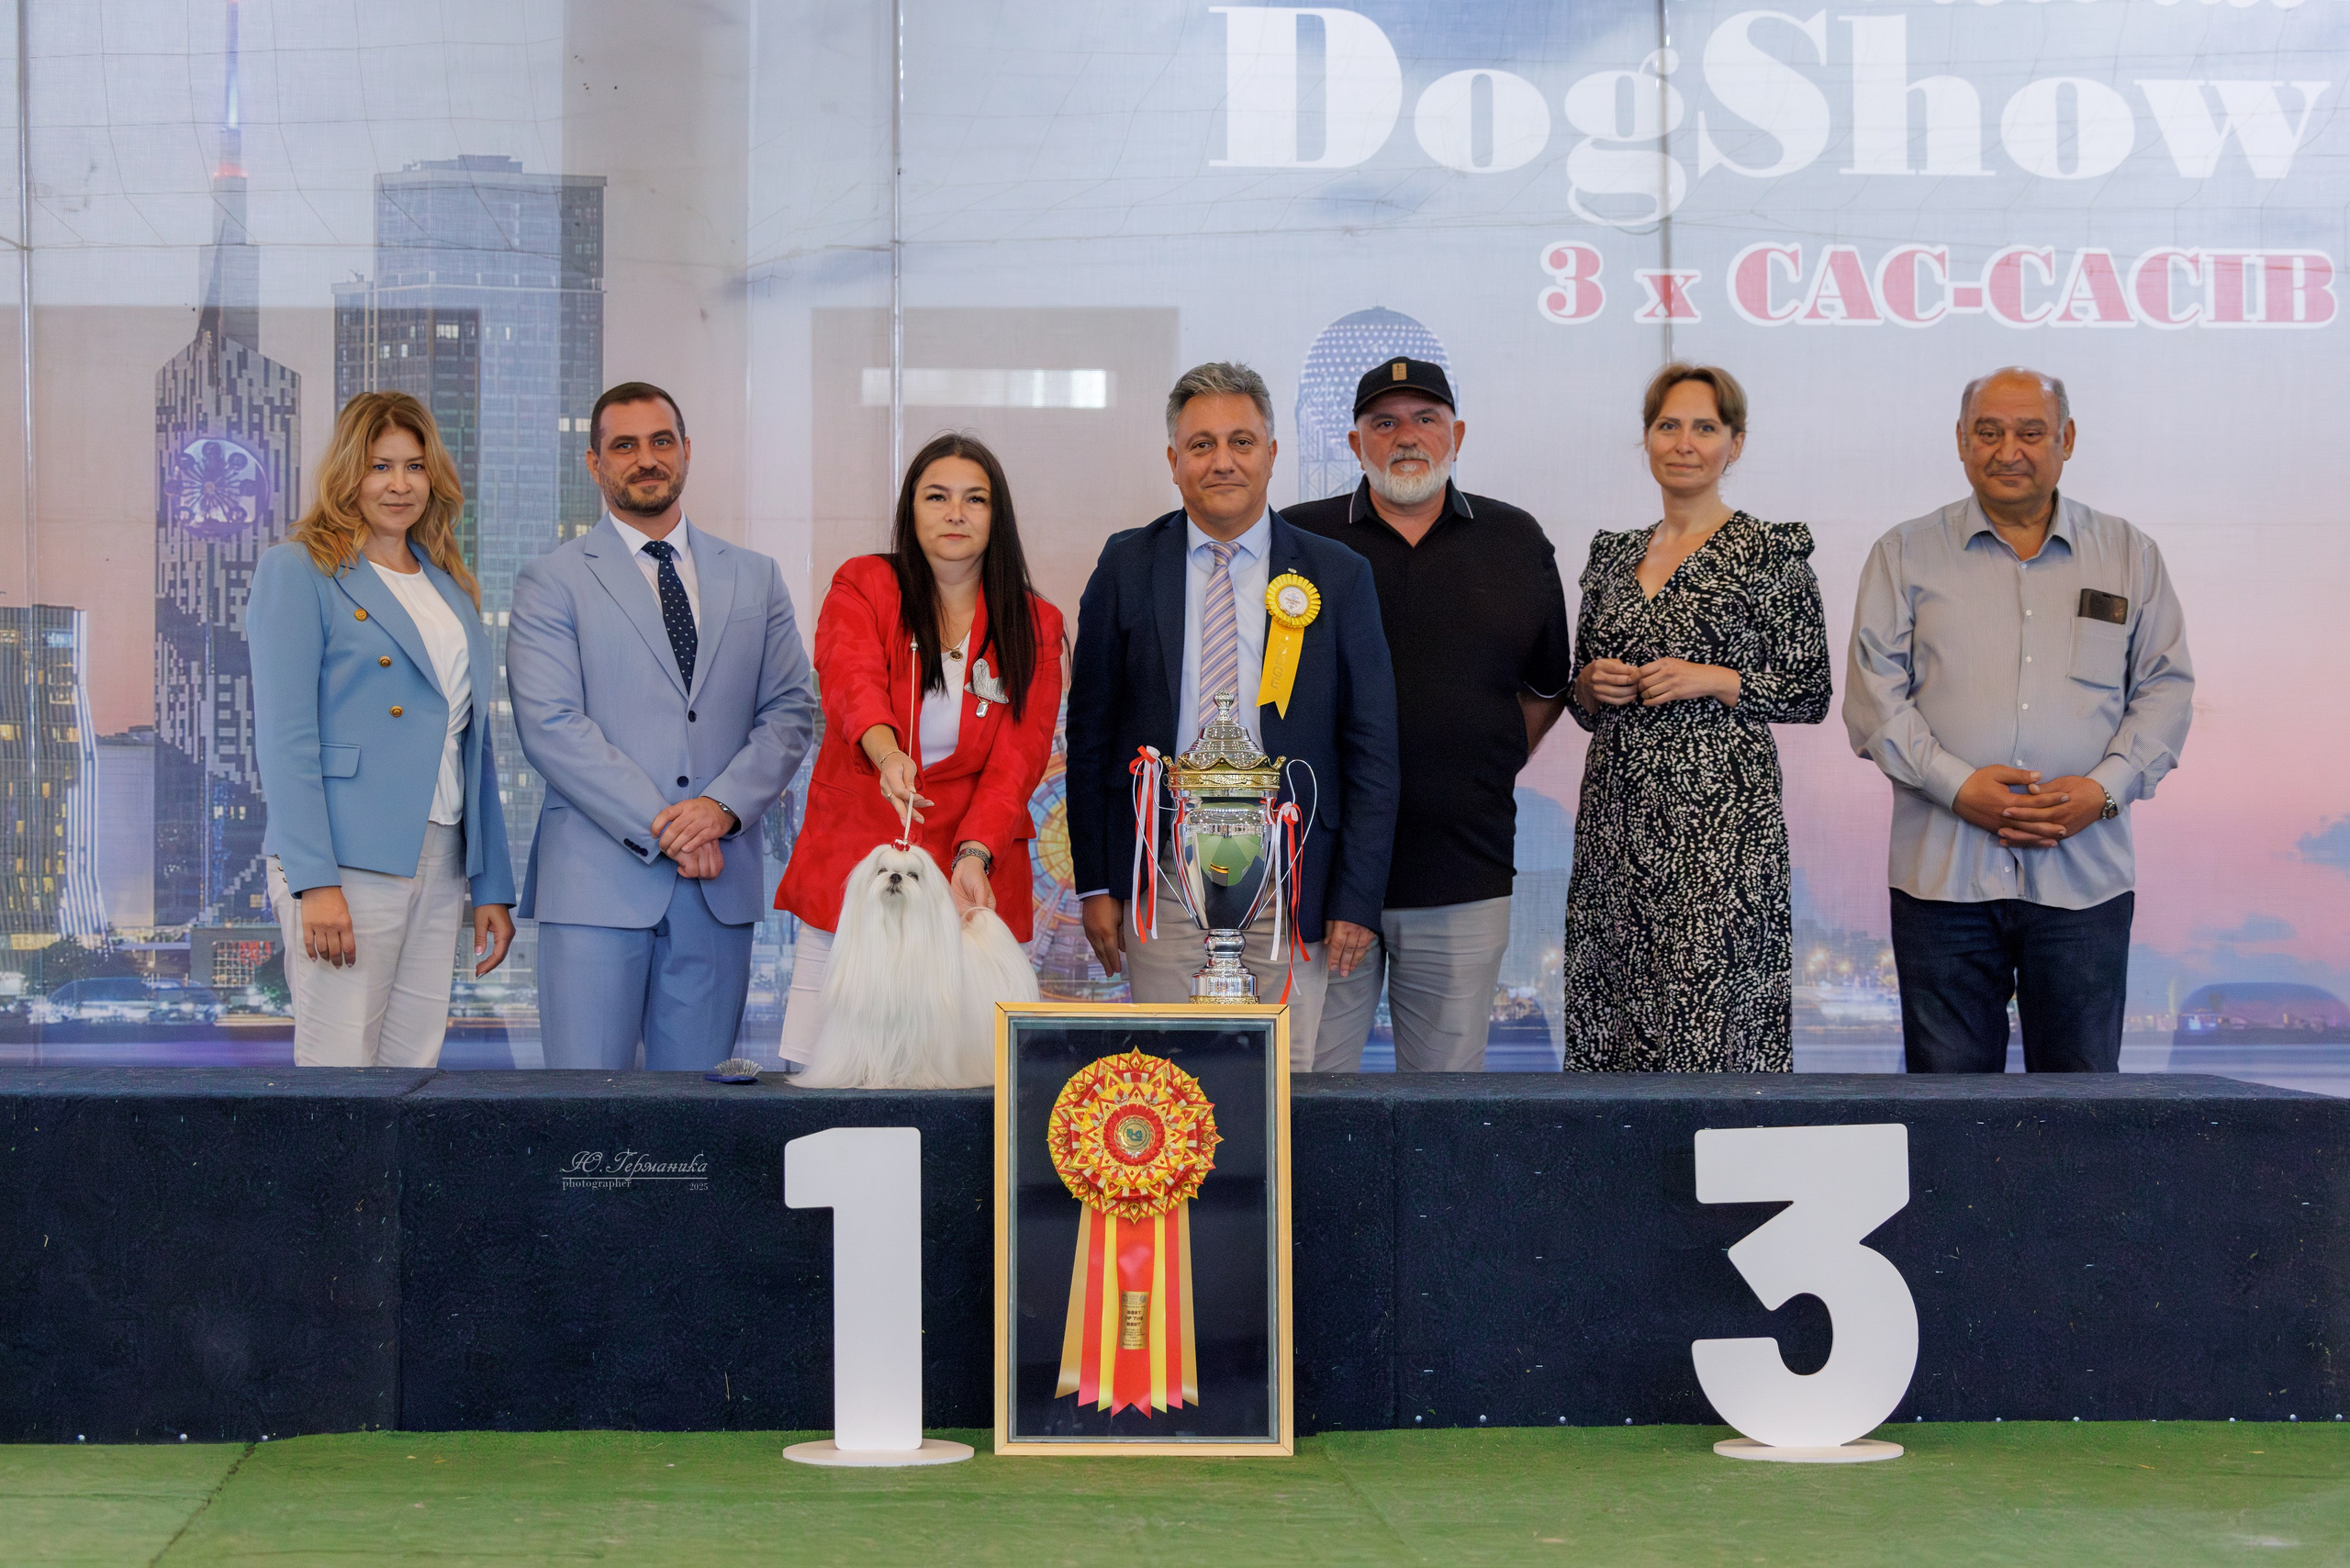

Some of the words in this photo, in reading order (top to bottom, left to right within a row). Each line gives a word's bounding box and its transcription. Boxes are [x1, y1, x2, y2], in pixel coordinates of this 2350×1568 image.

[1208, 5, 2330, 227] DogShow
[1539, 242, 1605, 324] 3
[1635, 268, 1701, 322] x
[1727, 242, 2338, 329] CAC-CACIB
[784, 1126, 923, 1450] 1
[1692, 1124, 1919, 1447] 3
